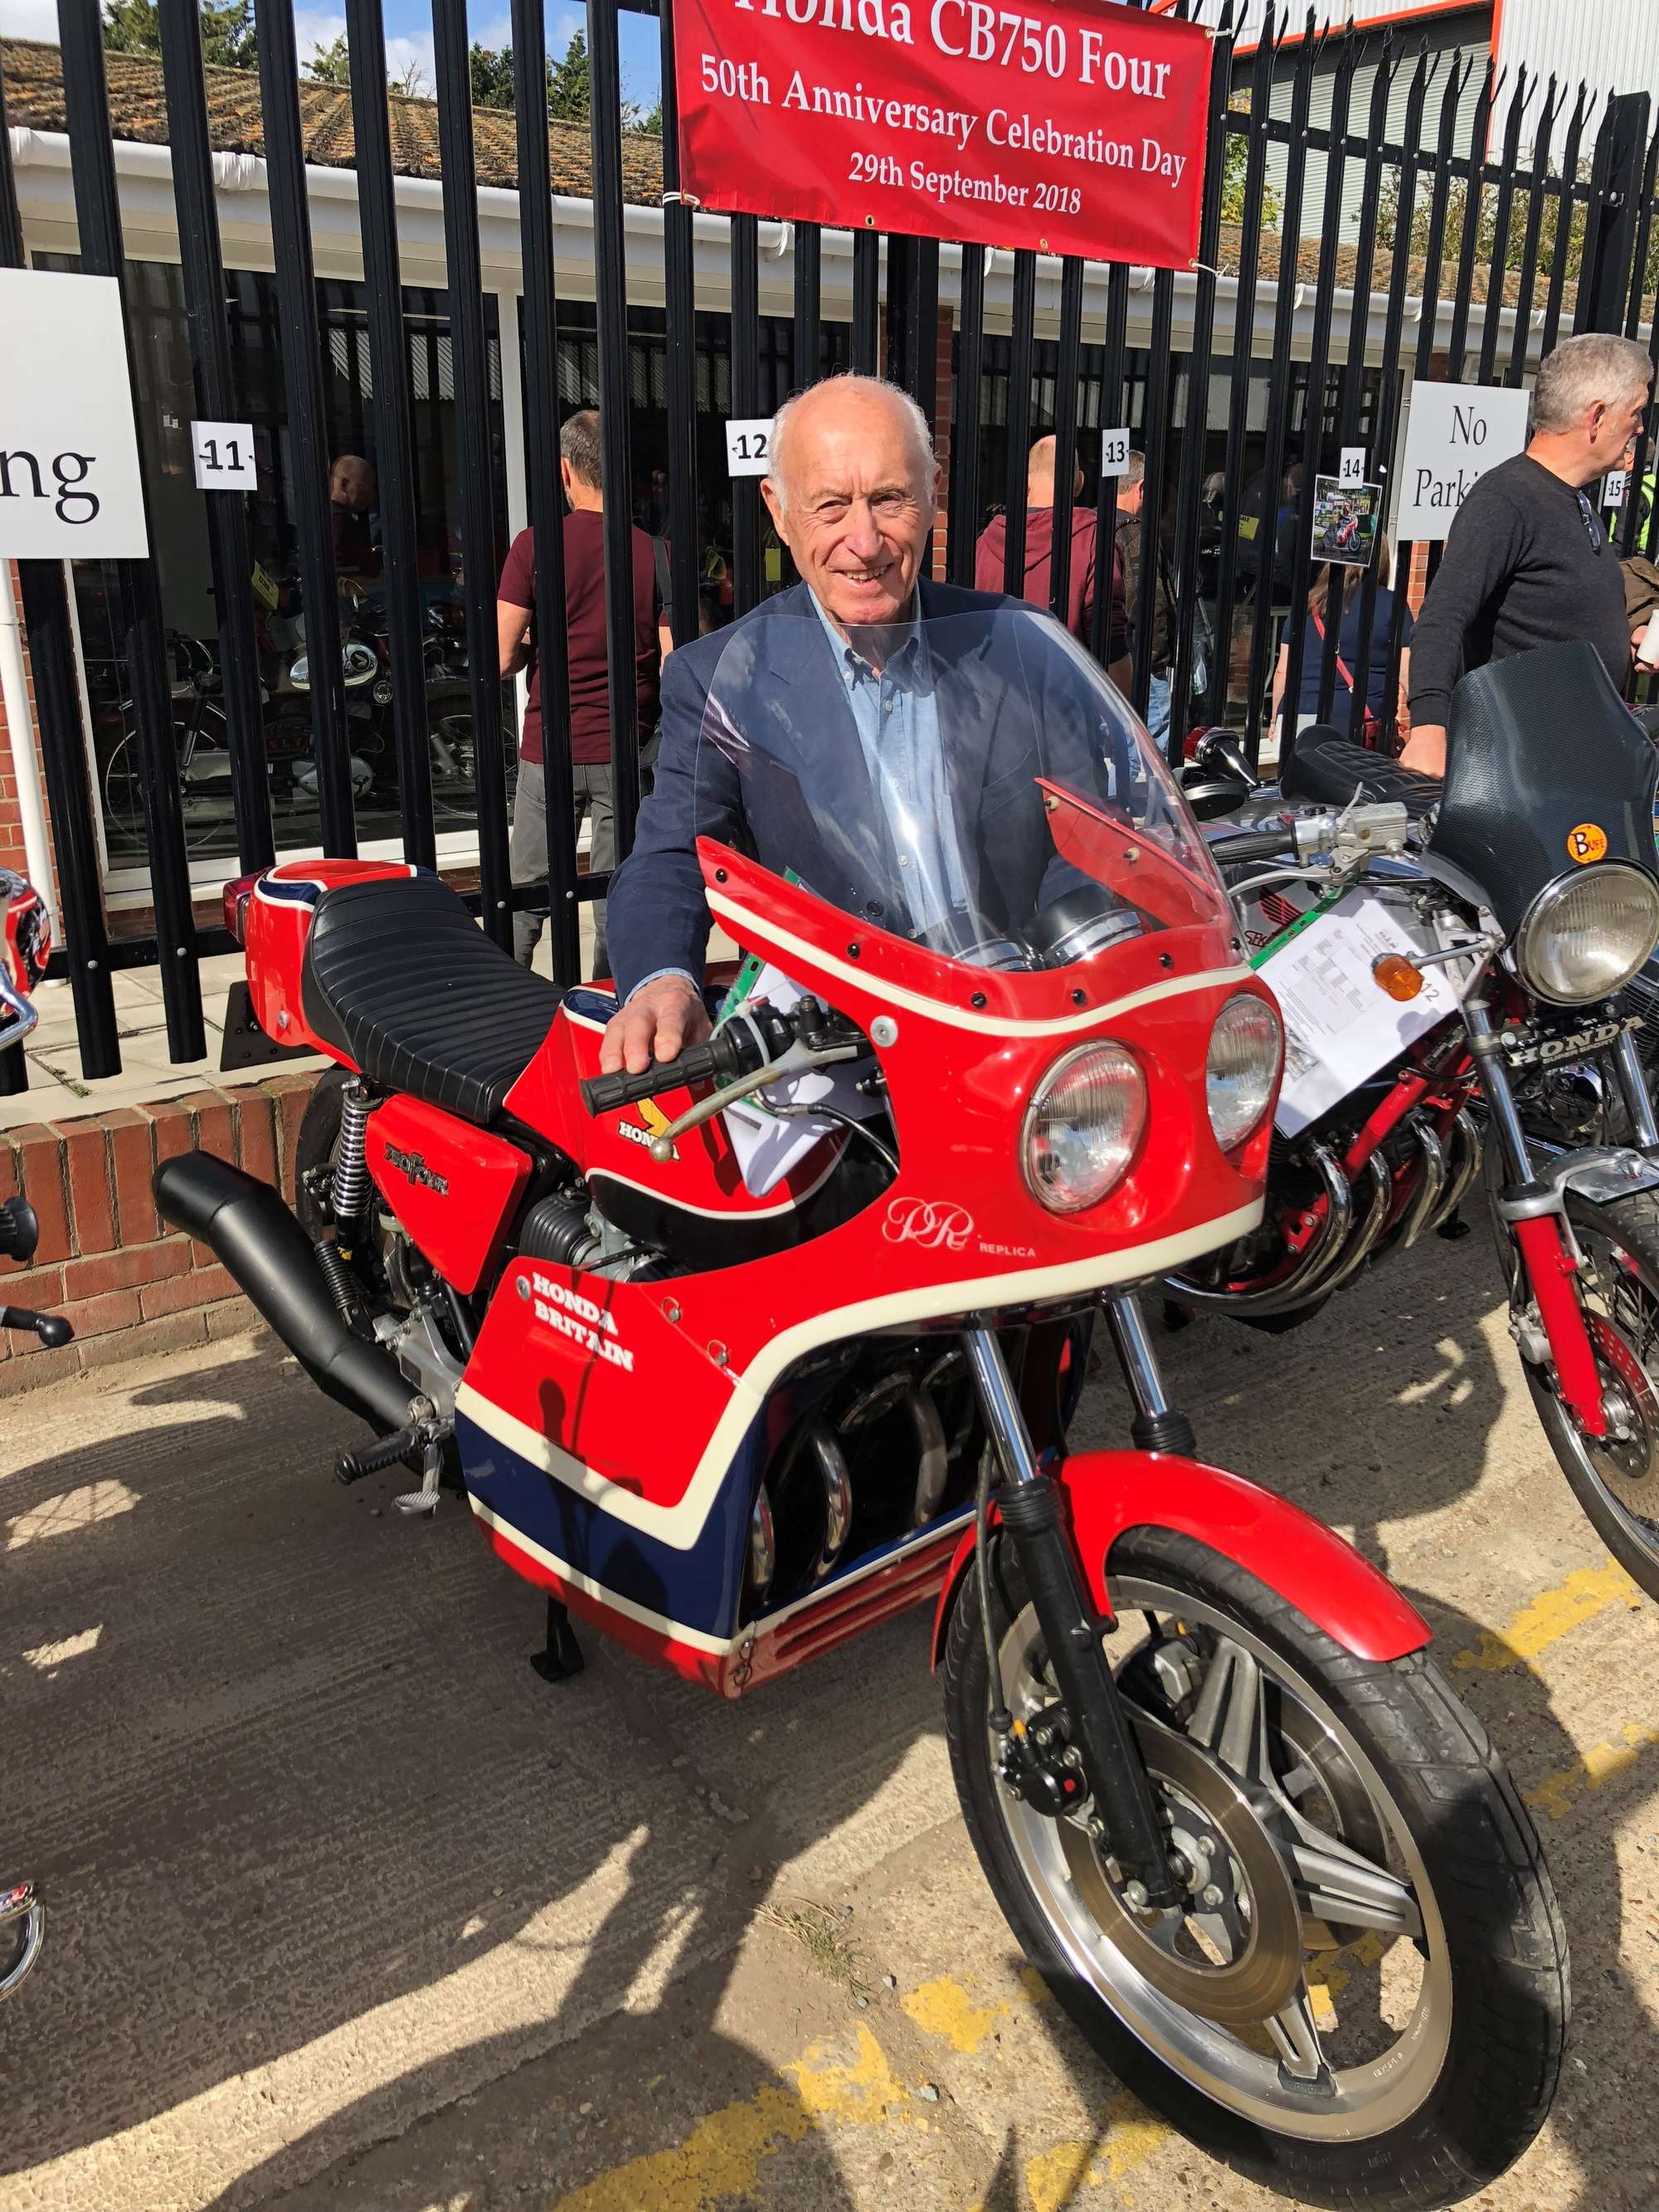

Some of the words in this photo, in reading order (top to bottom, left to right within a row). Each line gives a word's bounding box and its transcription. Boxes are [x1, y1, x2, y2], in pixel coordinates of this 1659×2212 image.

[734, 0, 915, 45] onda
[930, 0, 1067, 79] CB750
[1078, 28, 1172, 100] Four
[701, 53, 771, 105] 50th
[781, 70, 979, 151] Anniversary
[986, 109, 1134, 169] Celebration
[1141, 138, 1187, 188] Day
[848, 152, 904, 187] 29th
[910, 160, 1029, 207] September
[1033, 182, 1081, 215] 2018
[1449, 406, 1487, 445] No
[204, 439, 246, 471] 11
[737, 433, 768, 459] 12
[1107, 440, 1126, 464] 13
[0, 450, 100, 524] ng
[1344, 458, 1360, 478] 14
[1413, 469, 1478, 508] Park
[1609, 479, 1622, 497] 15
[1507, 1016, 1647, 1067] HONDA
[619, 1121, 680, 1160] HON
[979, 1242, 1036, 1257] REPLICA
[532, 1271, 619, 1336] HONDA
[533, 1298, 635, 1373] BRITAIN
